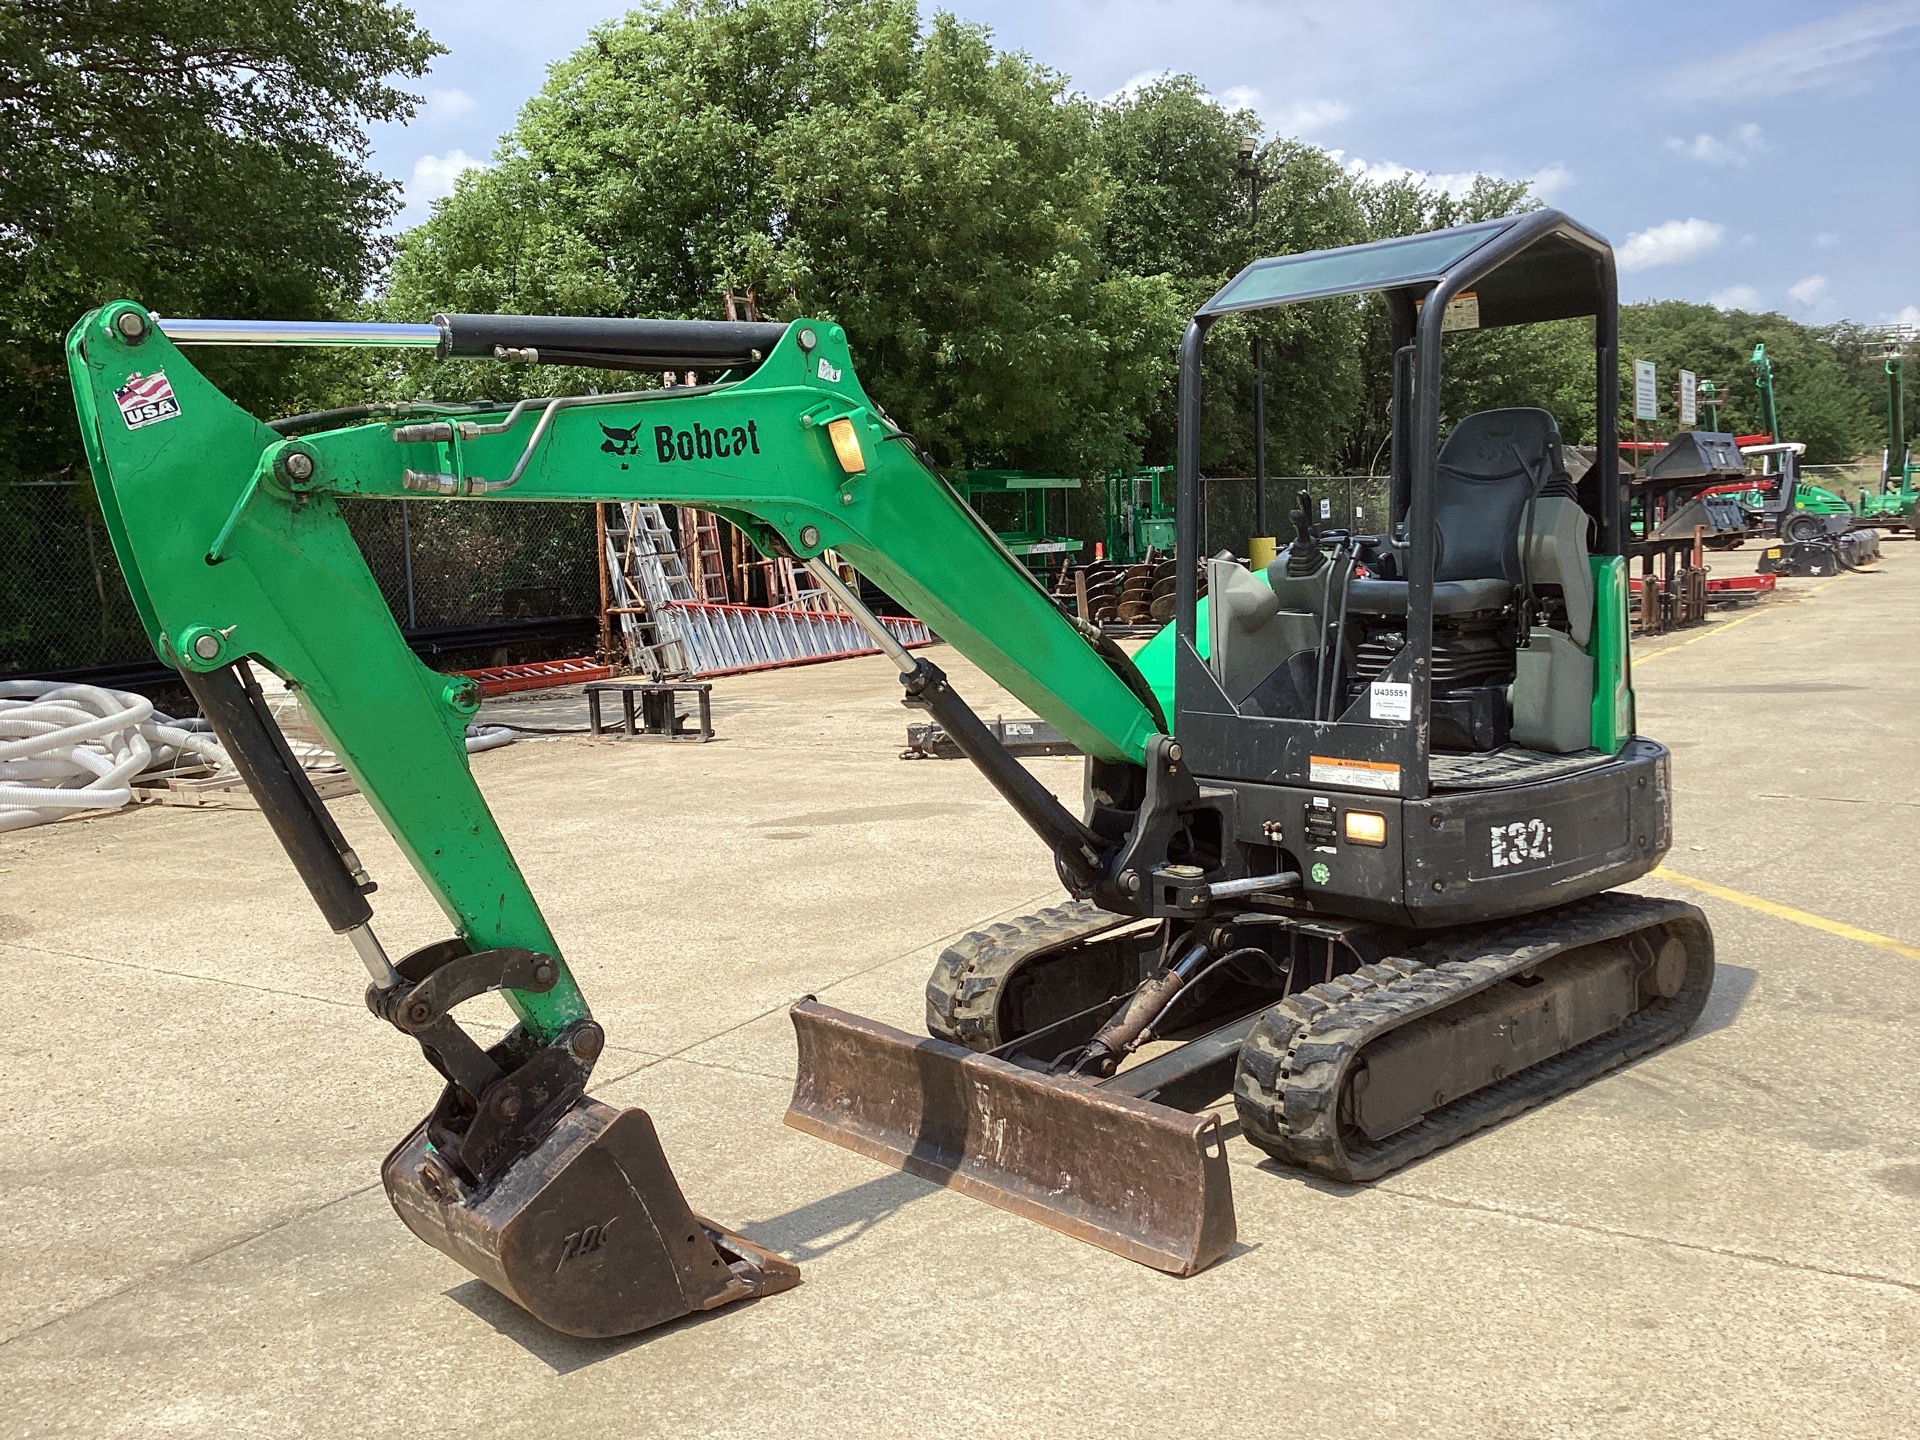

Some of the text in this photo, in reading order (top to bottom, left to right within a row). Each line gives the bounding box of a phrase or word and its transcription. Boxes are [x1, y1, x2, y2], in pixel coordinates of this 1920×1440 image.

[126, 399, 176, 423] USA
[653, 419, 760, 463] Bobcat
[1374, 688, 1408, 698] U435551
[1343, 760, 1371, 769] WARNING
